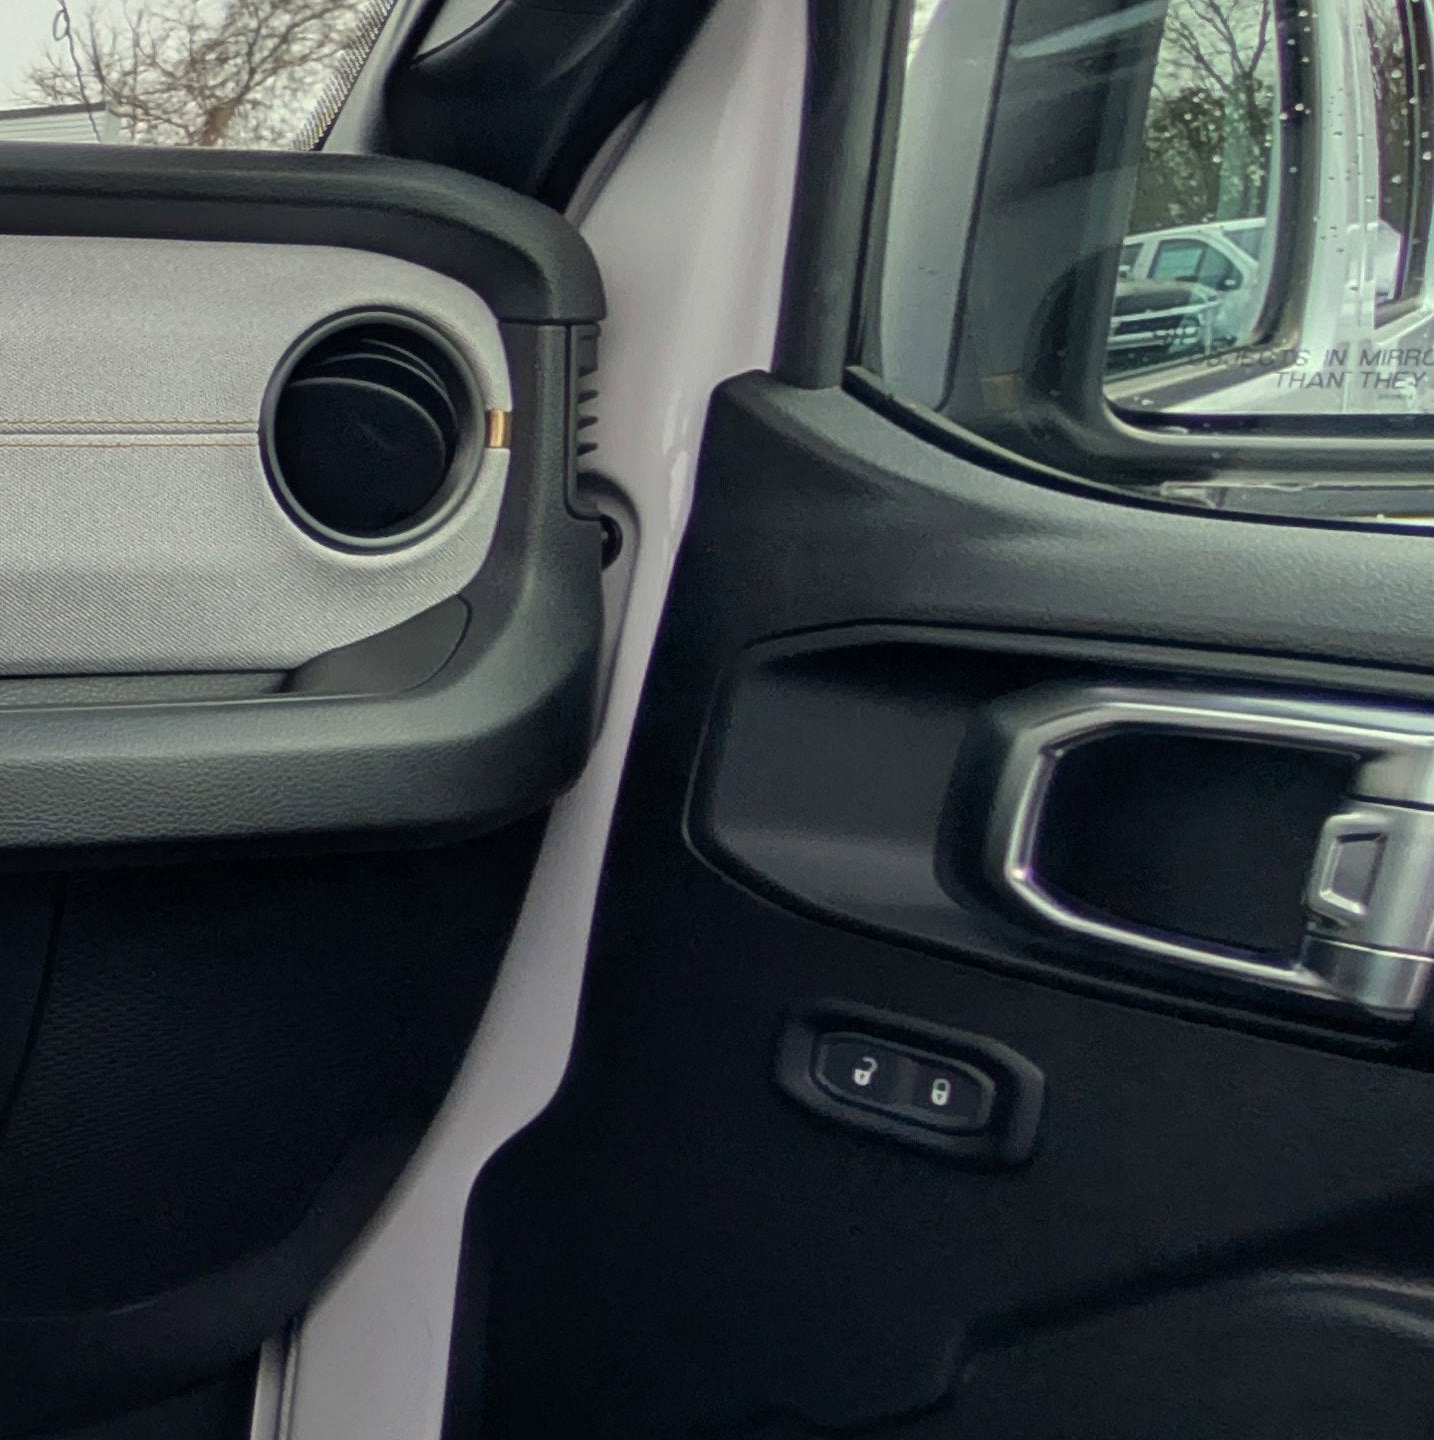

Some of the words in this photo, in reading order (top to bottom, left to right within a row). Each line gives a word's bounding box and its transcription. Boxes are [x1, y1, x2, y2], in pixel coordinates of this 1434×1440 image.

[1324, 349, 1347, 367] IN
[1273, 371, 1345, 389] THAN
[1359, 371, 1427, 389] THEY
